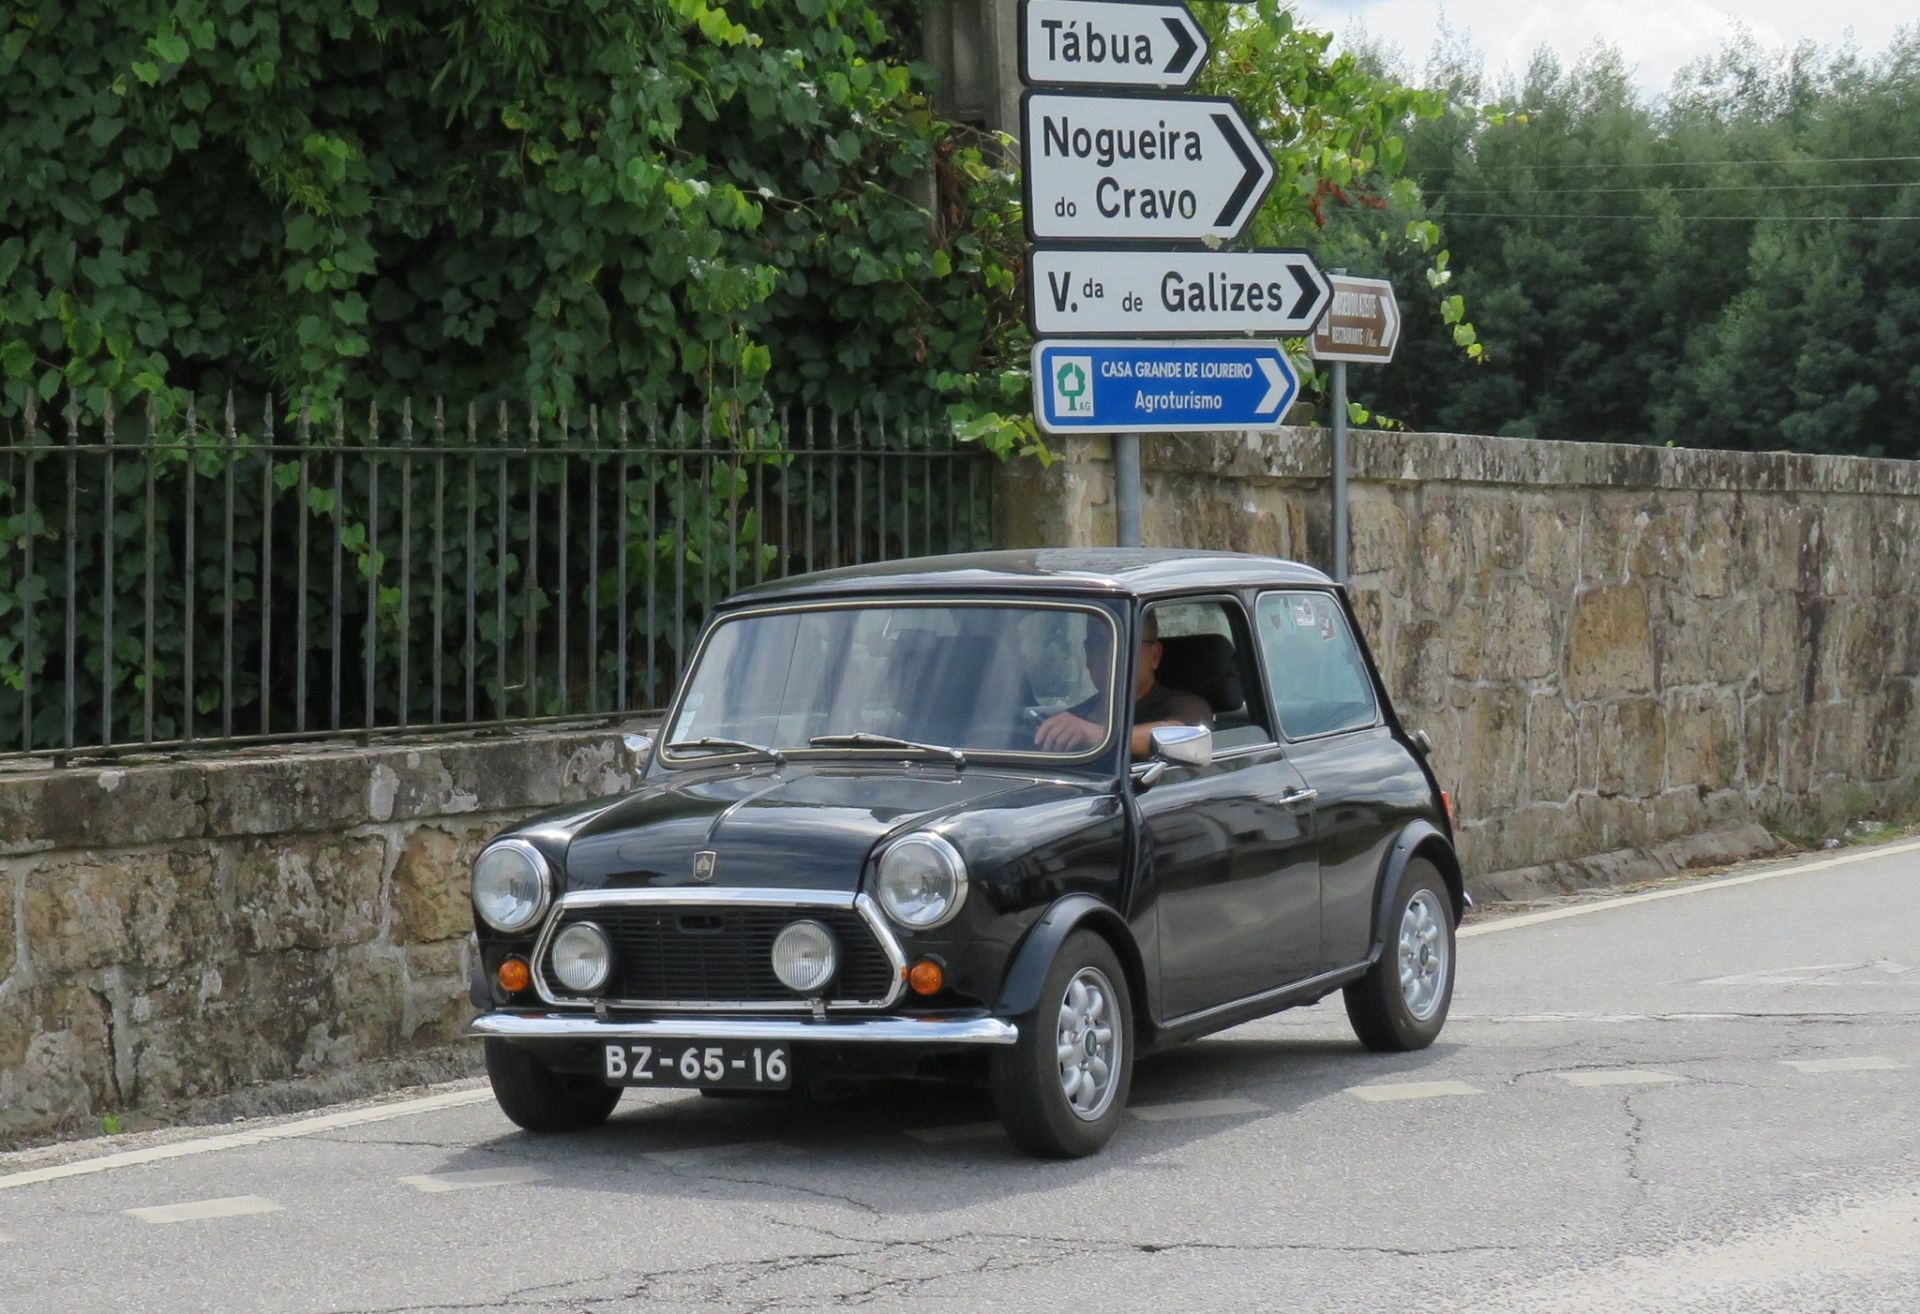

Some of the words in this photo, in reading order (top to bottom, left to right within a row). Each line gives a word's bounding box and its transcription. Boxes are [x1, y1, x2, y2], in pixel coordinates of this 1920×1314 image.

[1041, 20, 1153, 64] Tábua
[1043, 115, 1202, 167] Nogueira
[1055, 197, 1077, 218] do
[1096, 176, 1197, 219] Cravo
[1122, 292, 1143, 312] de
[1160, 271, 1283, 312] Galizes
[1101, 361, 1132, 378] CASA
[1135, 362, 1182, 378] GRANDE
[1184, 363, 1198, 378] DE
[1201, 363, 1252, 379] LOUREIRO
[1079, 402, 1091, 411] AG
[1135, 390, 1222, 412] Agroturismo
[605, 1045, 787, 1082] BZ-65-16
